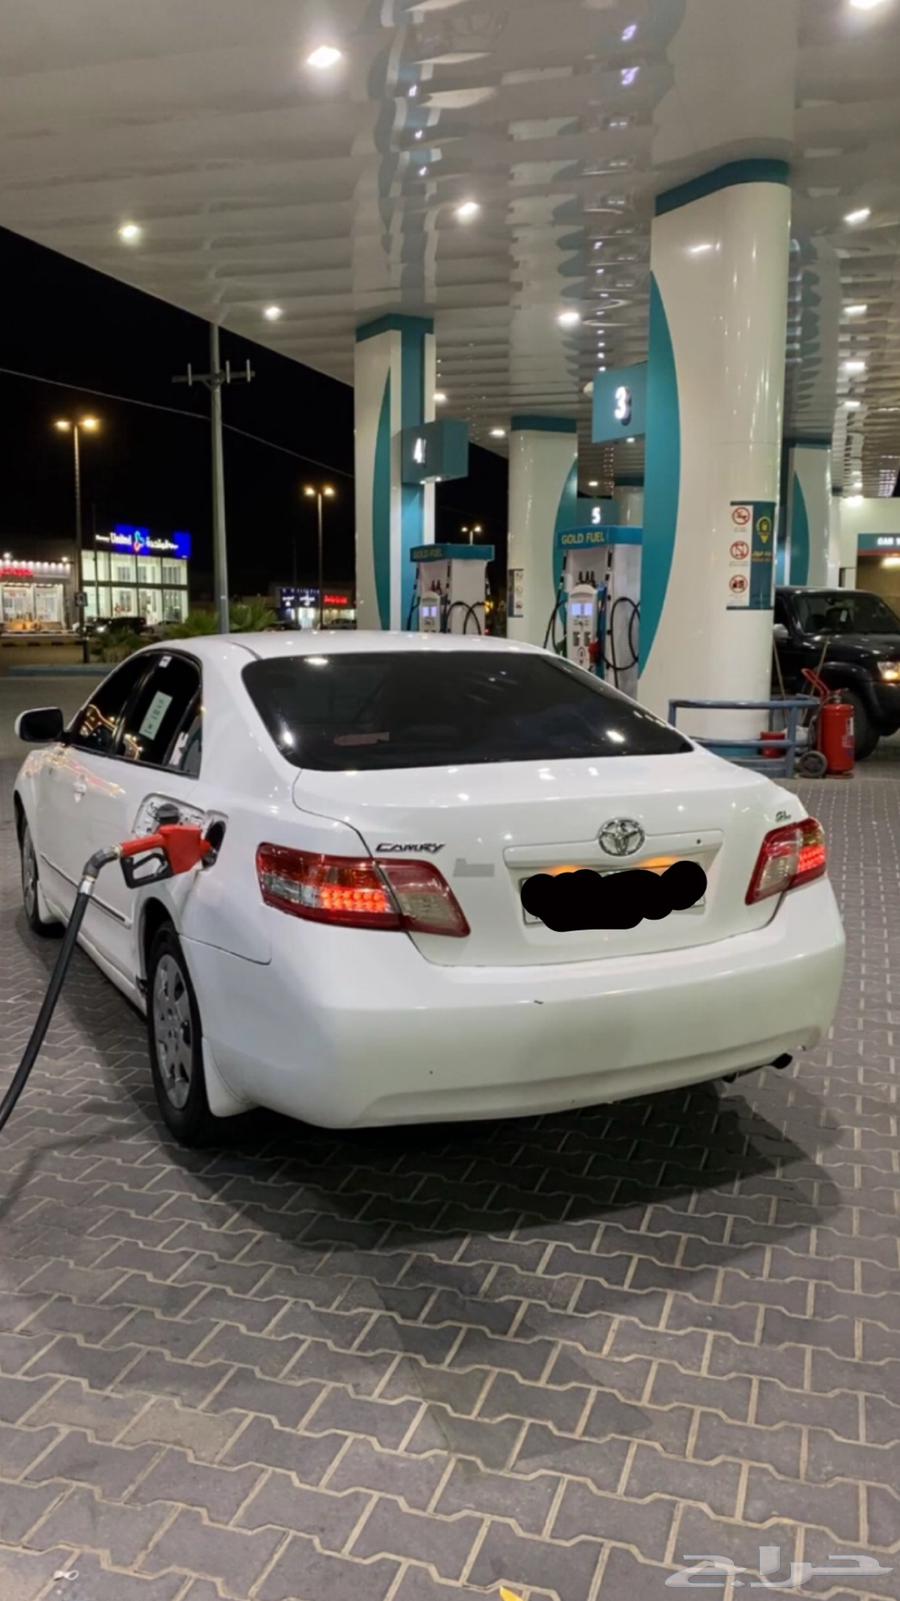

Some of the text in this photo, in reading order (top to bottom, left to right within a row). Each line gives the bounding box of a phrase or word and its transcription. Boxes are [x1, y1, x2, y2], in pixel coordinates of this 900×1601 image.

[614, 386, 629, 420] 3
[413, 437, 425, 463] 4
[591, 506, 601, 524] 5
[561, 531, 605, 545] GOLD FUEL
[375, 842, 447, 854] CAMRY
